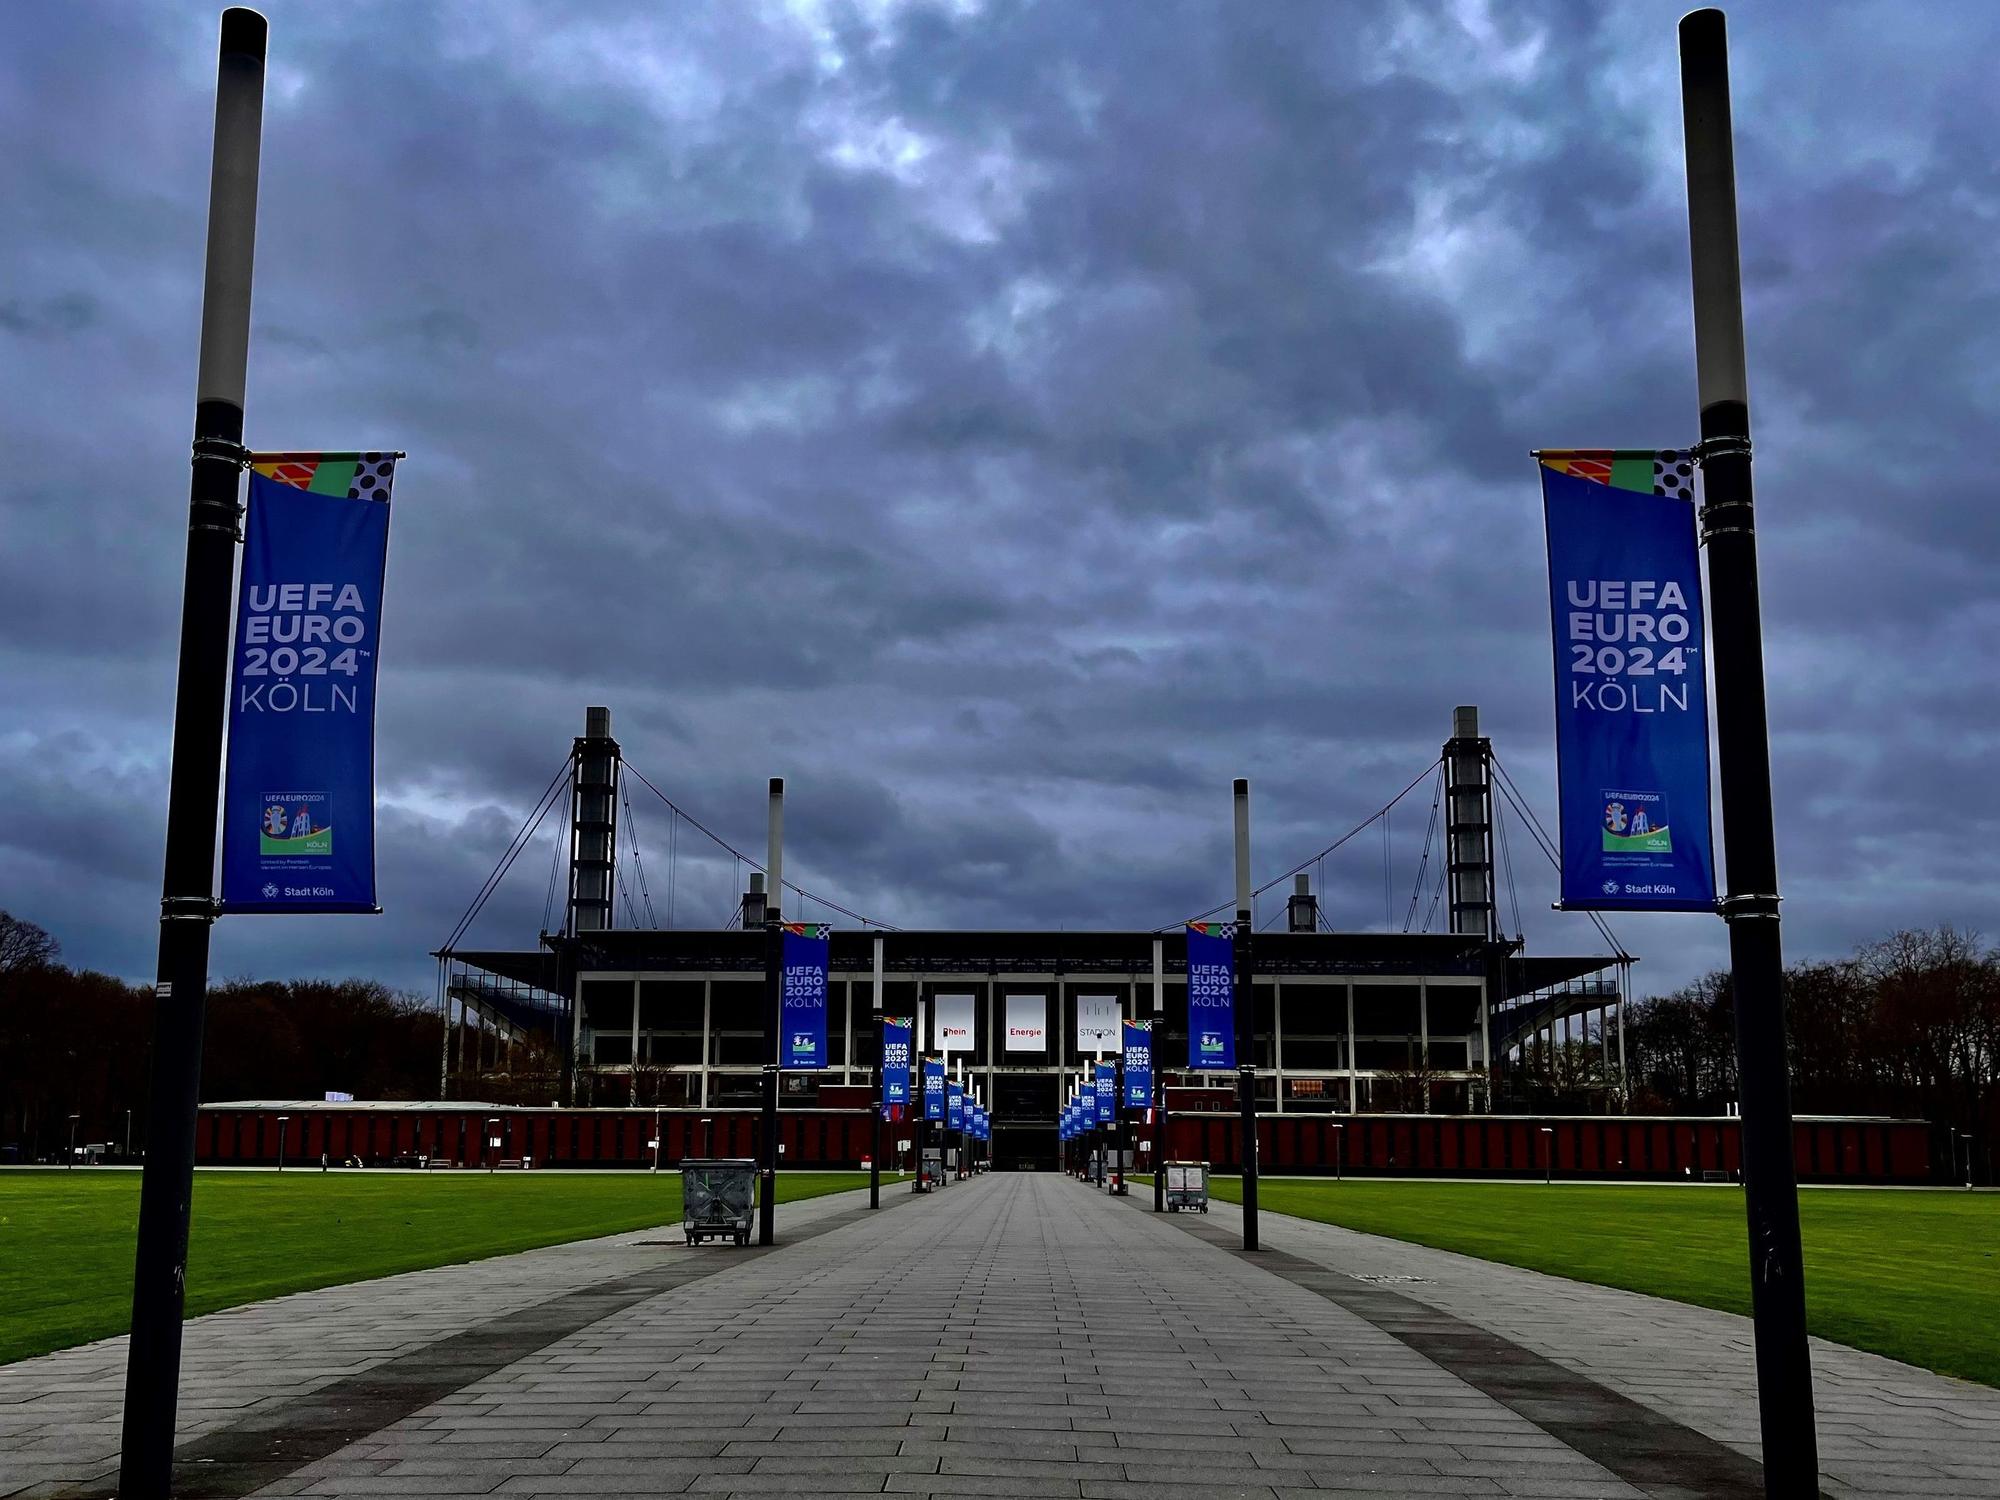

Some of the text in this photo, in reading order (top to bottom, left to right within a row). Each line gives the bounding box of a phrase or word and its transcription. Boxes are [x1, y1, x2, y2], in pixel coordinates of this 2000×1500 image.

[249, 583, 365, 612] UEFA
[1567, 580, 1688, 610] UEFA
[245, 615, 365, 644] EURO
[1569, 611, 1690, 642] EURO
[240, 677, 357, 713] KÖLN
[1572, 677, 1688, 713] KÖLN
[284, 887, 335, 896] Stadt Köln
[1625, 884, 1676, 894] Stadt Köln
[786, 966, 823, 976] UEFA
[1191, 964, 1230, 975] UEFA
[785, 976, 824, 986] EURO
[1192, 975, 1230, 985] EURO
[1010, 1028, 1041, 1037] Energie
